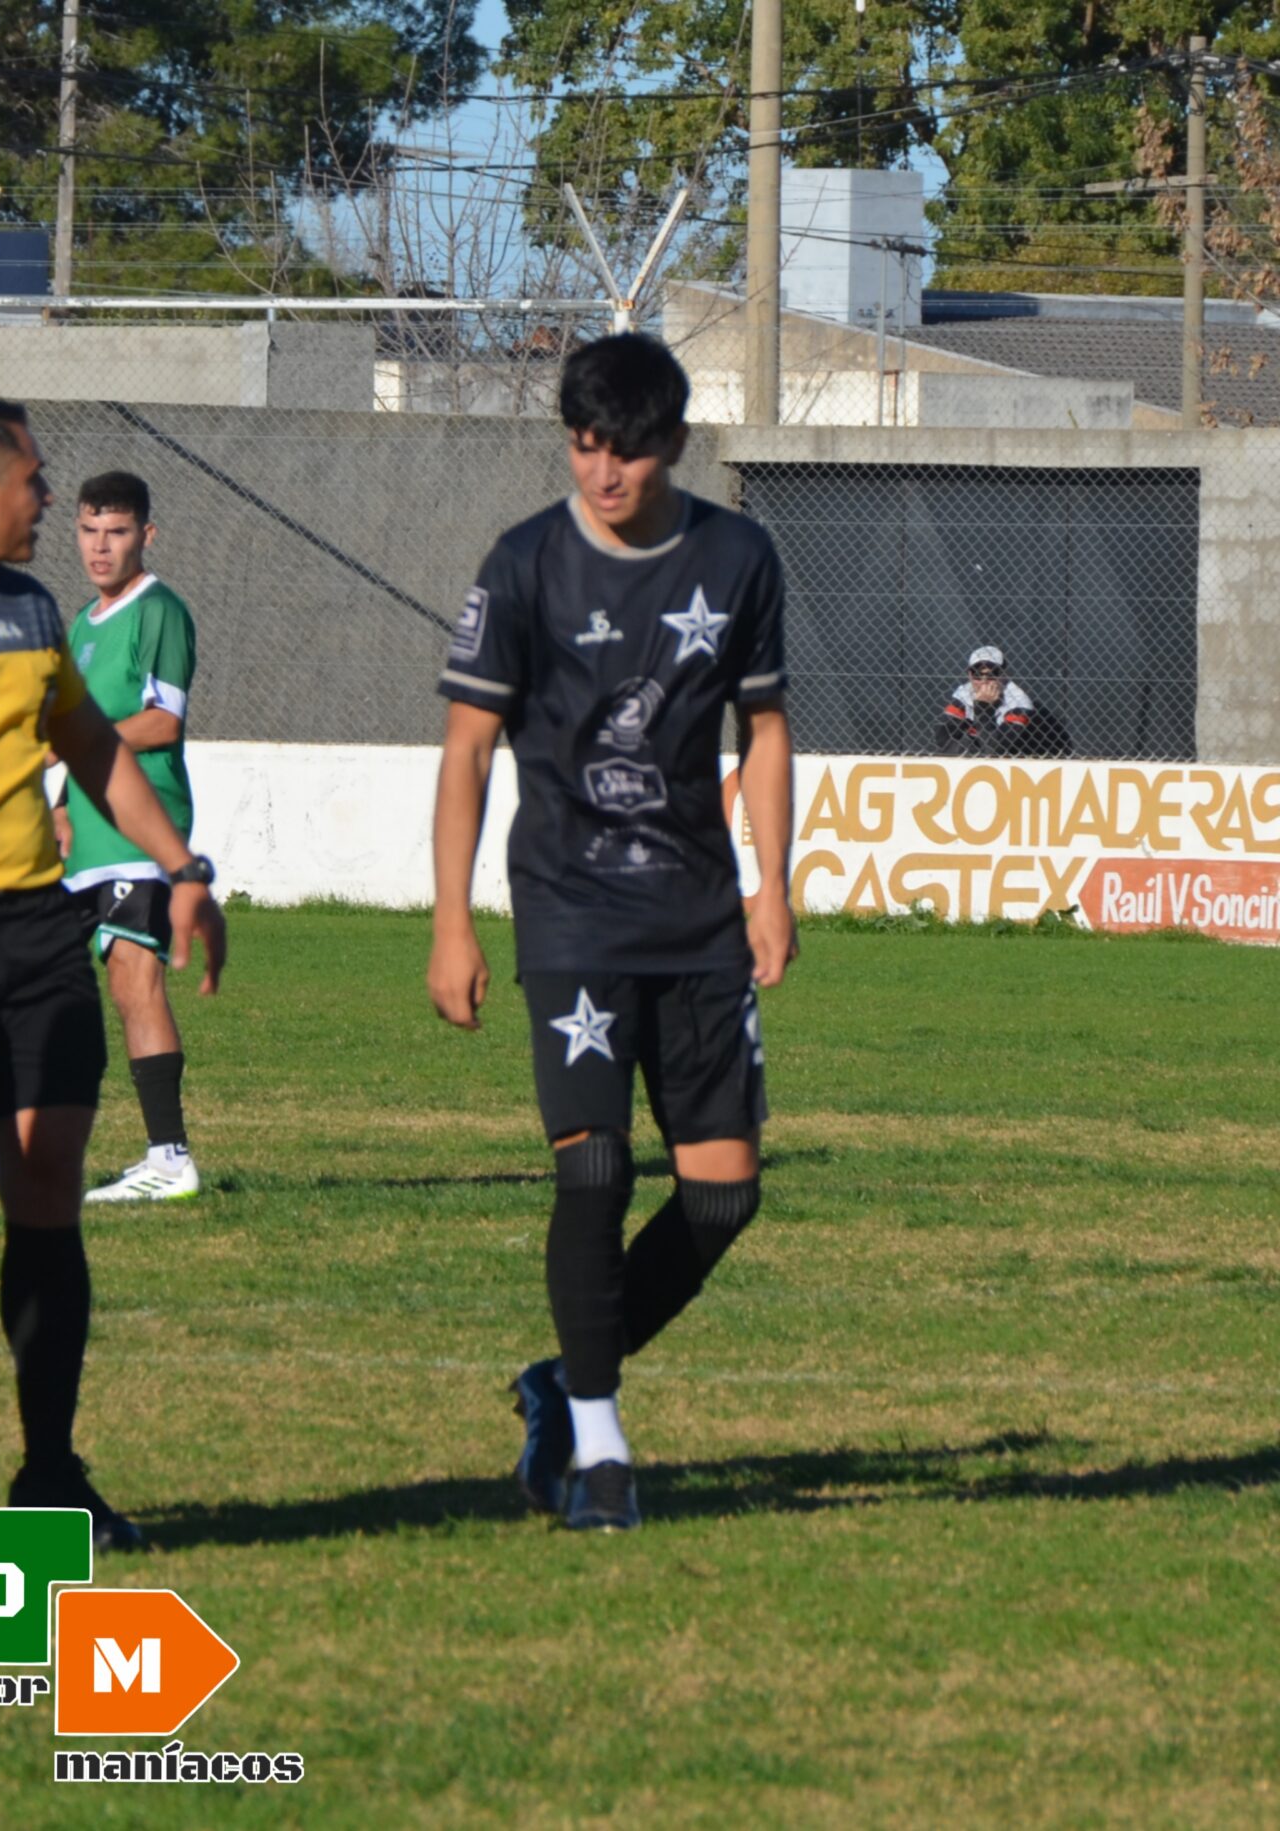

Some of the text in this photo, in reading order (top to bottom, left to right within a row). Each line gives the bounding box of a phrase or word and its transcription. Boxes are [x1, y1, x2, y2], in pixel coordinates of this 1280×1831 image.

[798, 763, 1280, 854] AGROMADERAS
[791, 849, 1088, 924] CASTEX
[1101, 871, 1163, 924] Raúl
